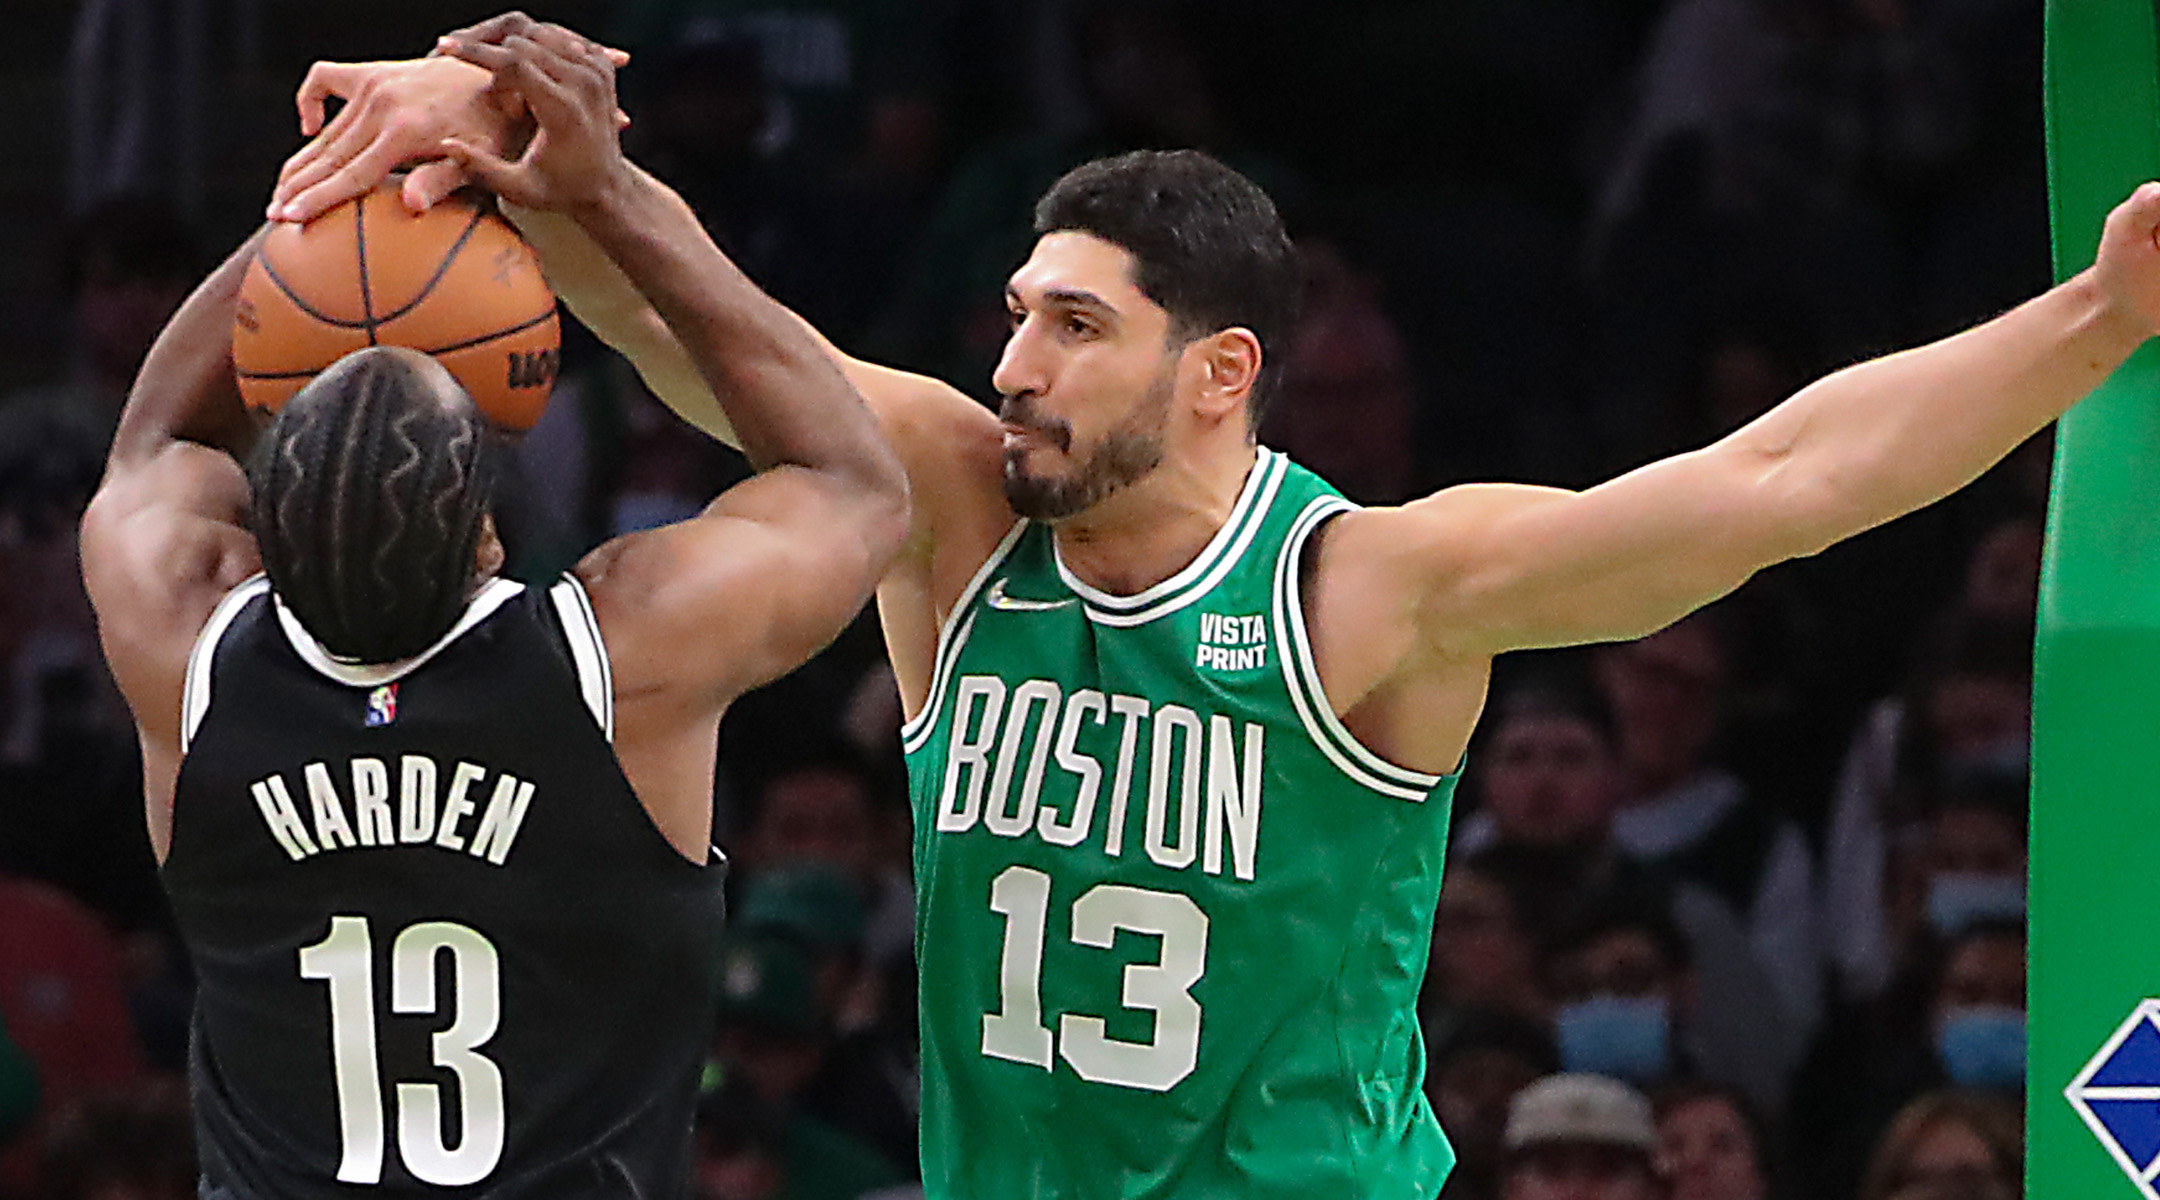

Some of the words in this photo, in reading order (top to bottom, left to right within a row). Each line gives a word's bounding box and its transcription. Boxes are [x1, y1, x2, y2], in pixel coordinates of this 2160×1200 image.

[1196, 643, 1267, 671] PRINT
[1200, 612, 1267, 645] VISTA
[250, 754, 536, 866] HARDEN
[937, 675, 1265, 881] BOSTON
[300, 915, 506, 1186] 13
[981, 866, 1210, 1091] 13
